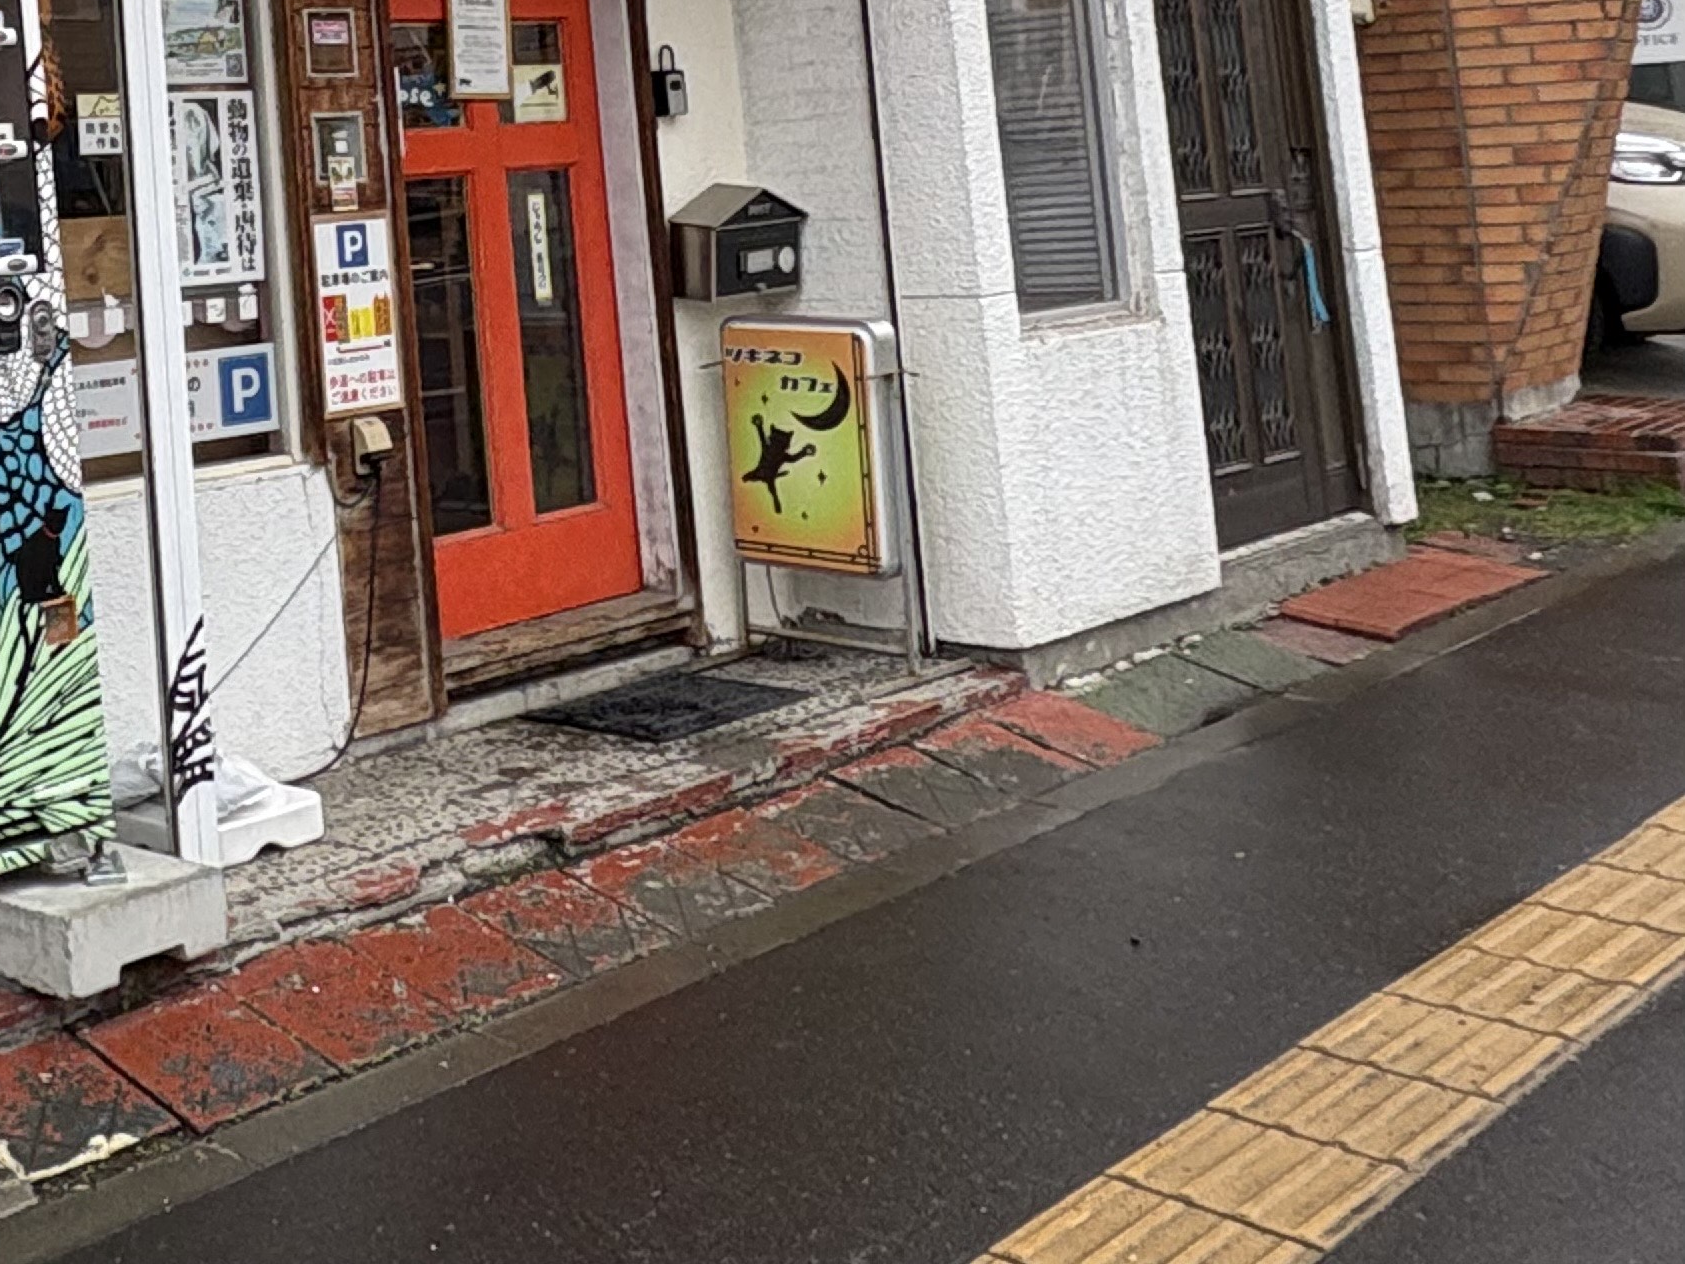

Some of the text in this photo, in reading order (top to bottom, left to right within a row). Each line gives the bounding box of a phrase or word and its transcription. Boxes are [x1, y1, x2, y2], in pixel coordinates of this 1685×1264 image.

[343, 229, 363, 262] P
[725, 347, 802, 366] ツキネコ
[231, 366, 262, 414] P
[779, 375, 835, 394] カフェ
